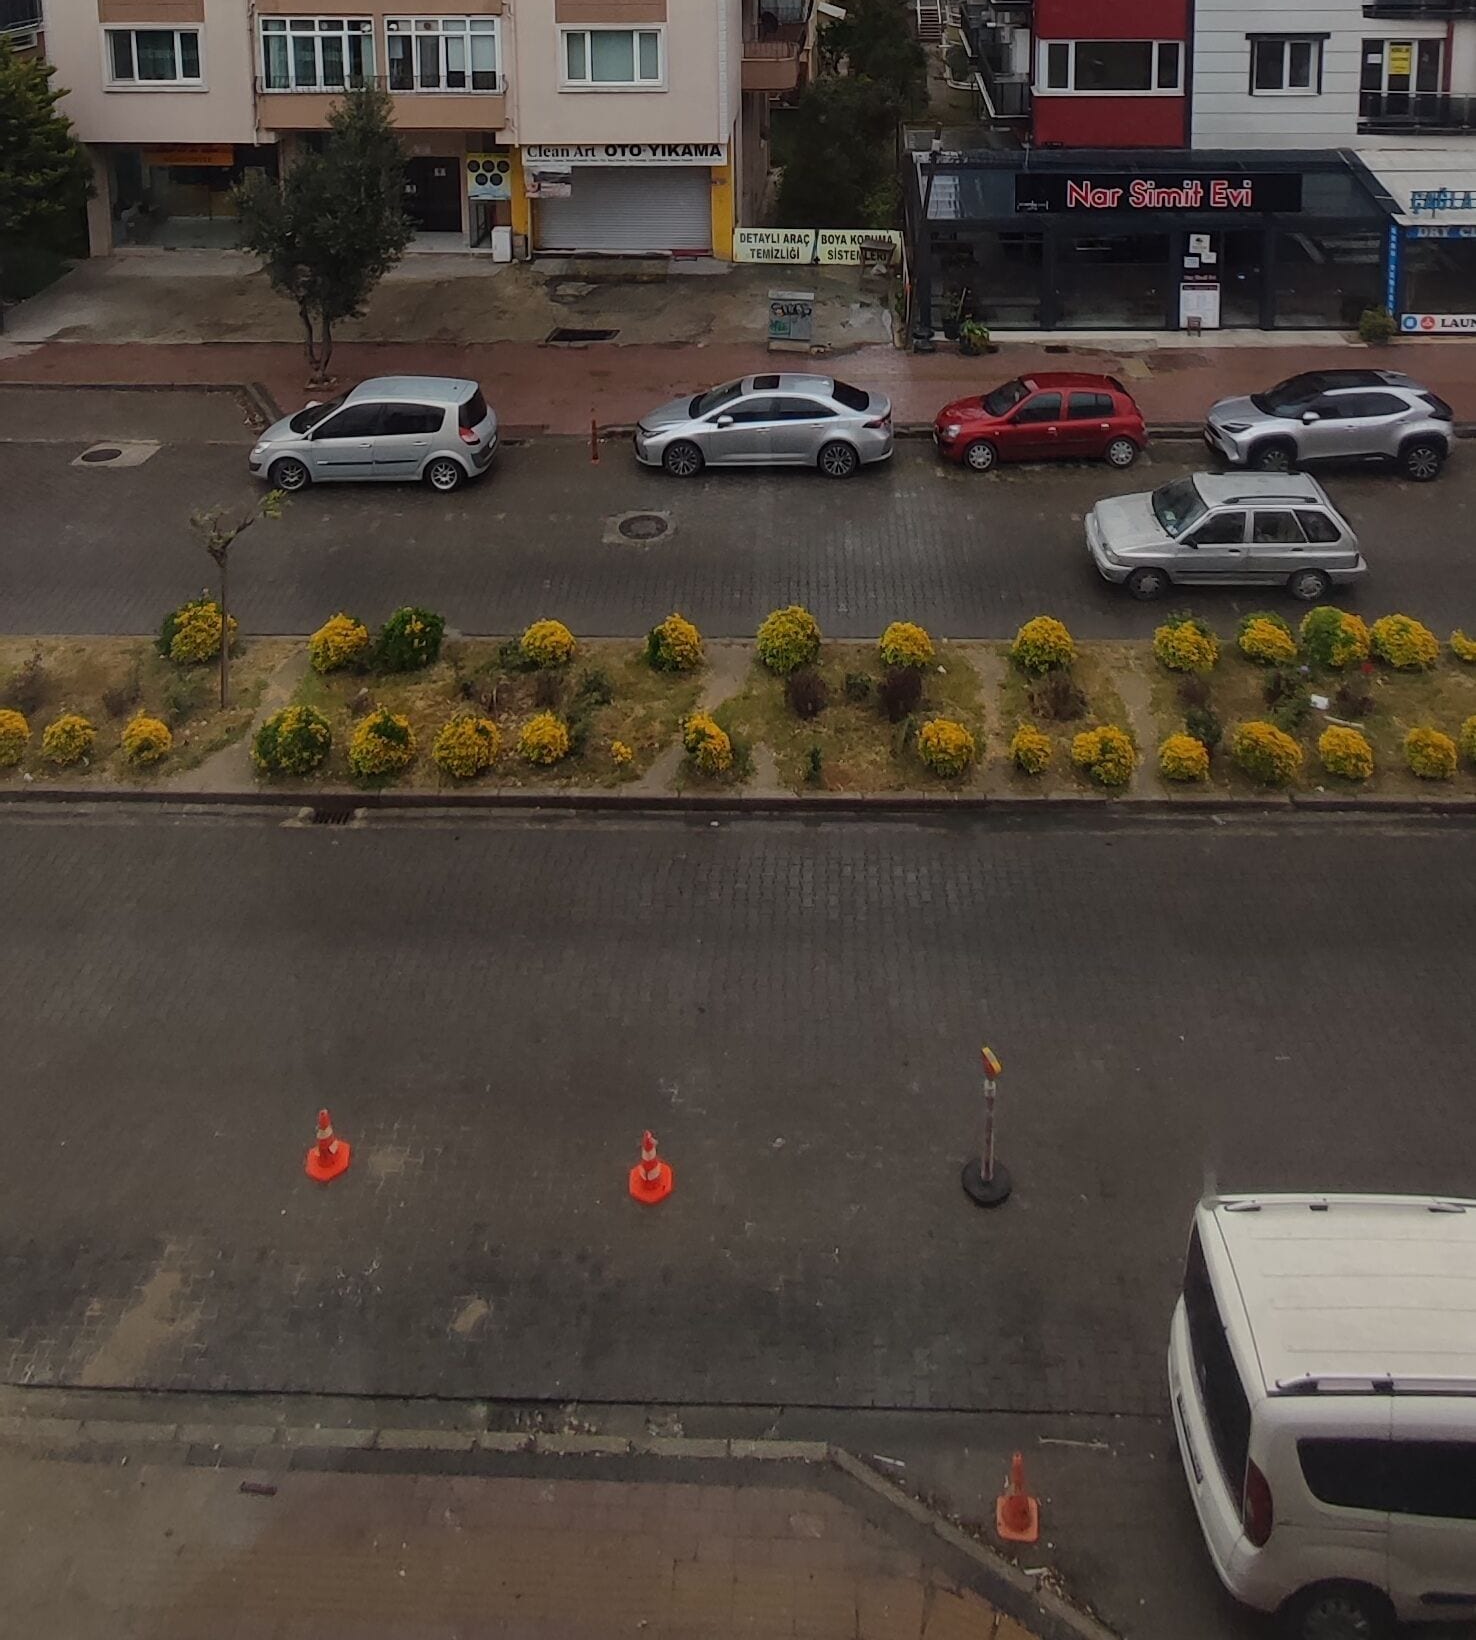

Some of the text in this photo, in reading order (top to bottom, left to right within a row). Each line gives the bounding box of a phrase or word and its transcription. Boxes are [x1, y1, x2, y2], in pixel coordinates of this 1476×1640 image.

[527, 143, 722, 158] Clean Art OTO YIKAMA
[1066, 179, 1253, 208] Nar Simit Evi
[1417, 227, 1450, 238] DRY
[739, 233, 810, 247] DETAYLI ARAÇ
[821, 234, 847, 245] BOYA
[750, 247, 800, 260] TEMİZLİĞİ
